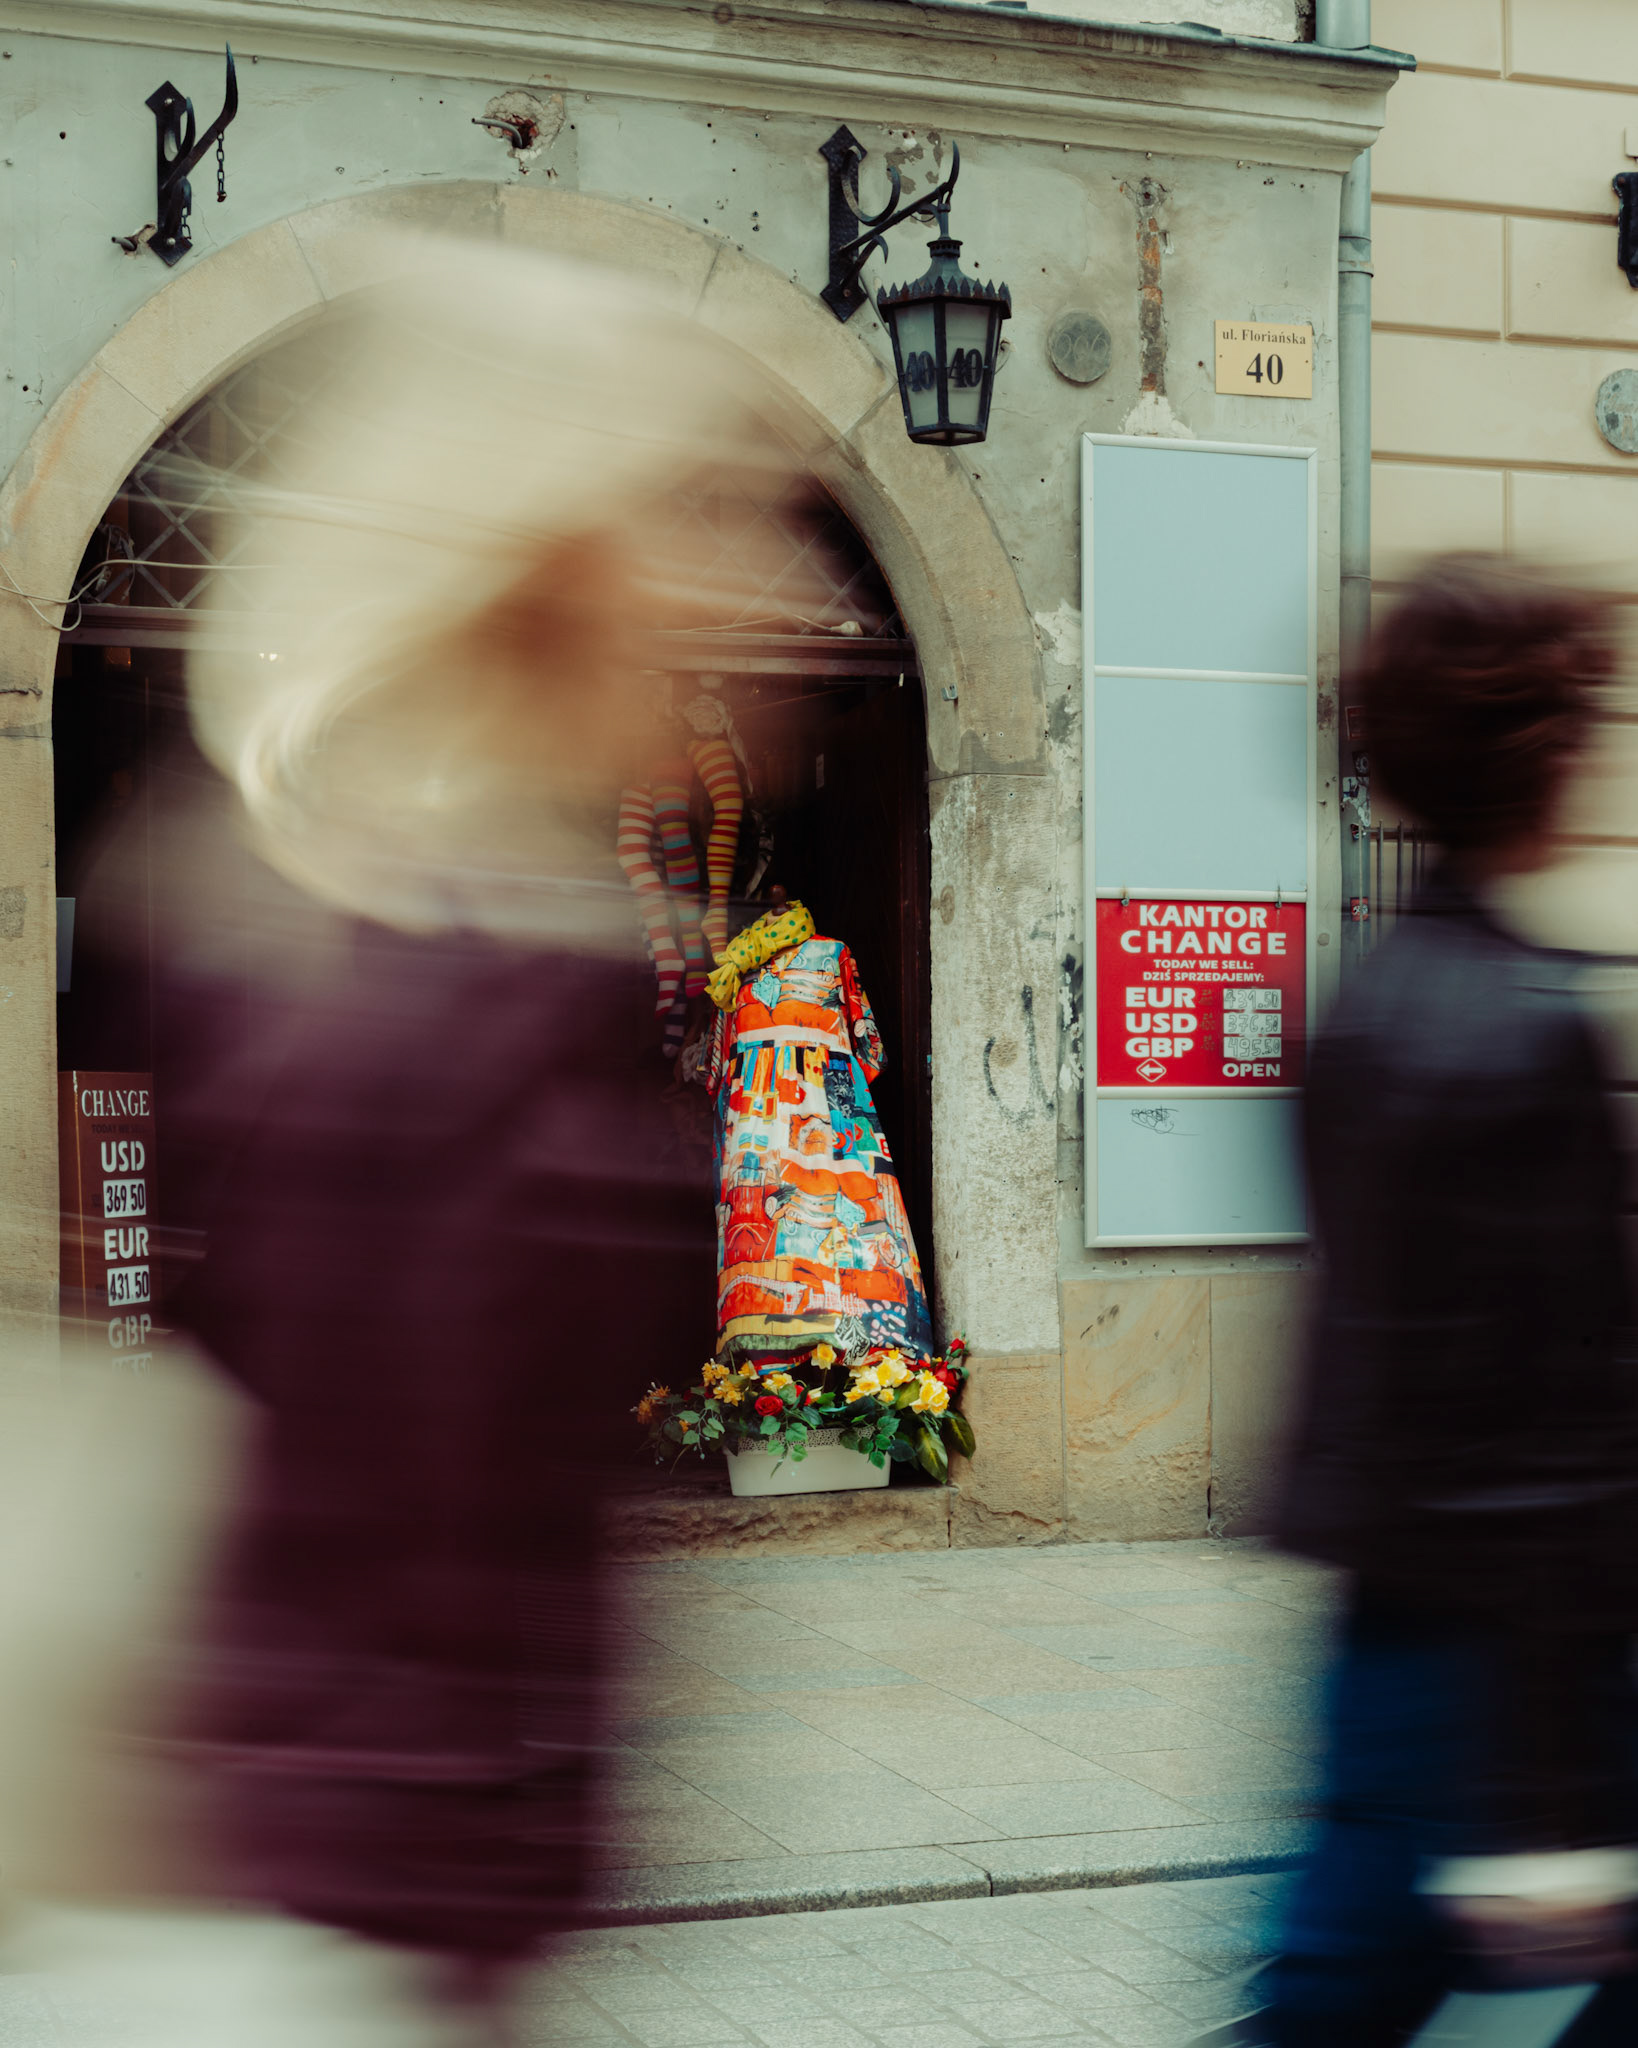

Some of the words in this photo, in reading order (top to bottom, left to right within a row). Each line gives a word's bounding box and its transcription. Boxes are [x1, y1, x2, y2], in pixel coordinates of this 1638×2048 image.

[1222, 329, 1238, 341] ul.
[1242, 329, 1306, 345] Floriańska
[905, 350, 936, 392] 40
[948, 347, 983, 388] 40
[1246, 352, 1283, 385] 40
[1139, 904, 1268, 928] KANTOR
[1120, 929, 1287, 955] CHANGE
[1143, 969, 1171, 981] DZIŚ
[1174, 972, 1265, 982] SPRZEDAJEMY:
[1153, 959, 1196, 969] TODAY
[1199, 960, 1218, 969] WE
[1221, 960, 1254, 970] SELL:
[1125, 986, 1196, 1008] EUR
[1125, 1012, 1198, 1034] USD
[1125, 1037, 1194, 1058] GBP
[1222, 1063, 1281, 1077] OPEN
[81, 1089, 150, 1117] CHANGE
[101, 1140, 146, 1173] USD
[104, 1226, 149, 1260] EUR
[108, 1313, 152, 1349] GBP
